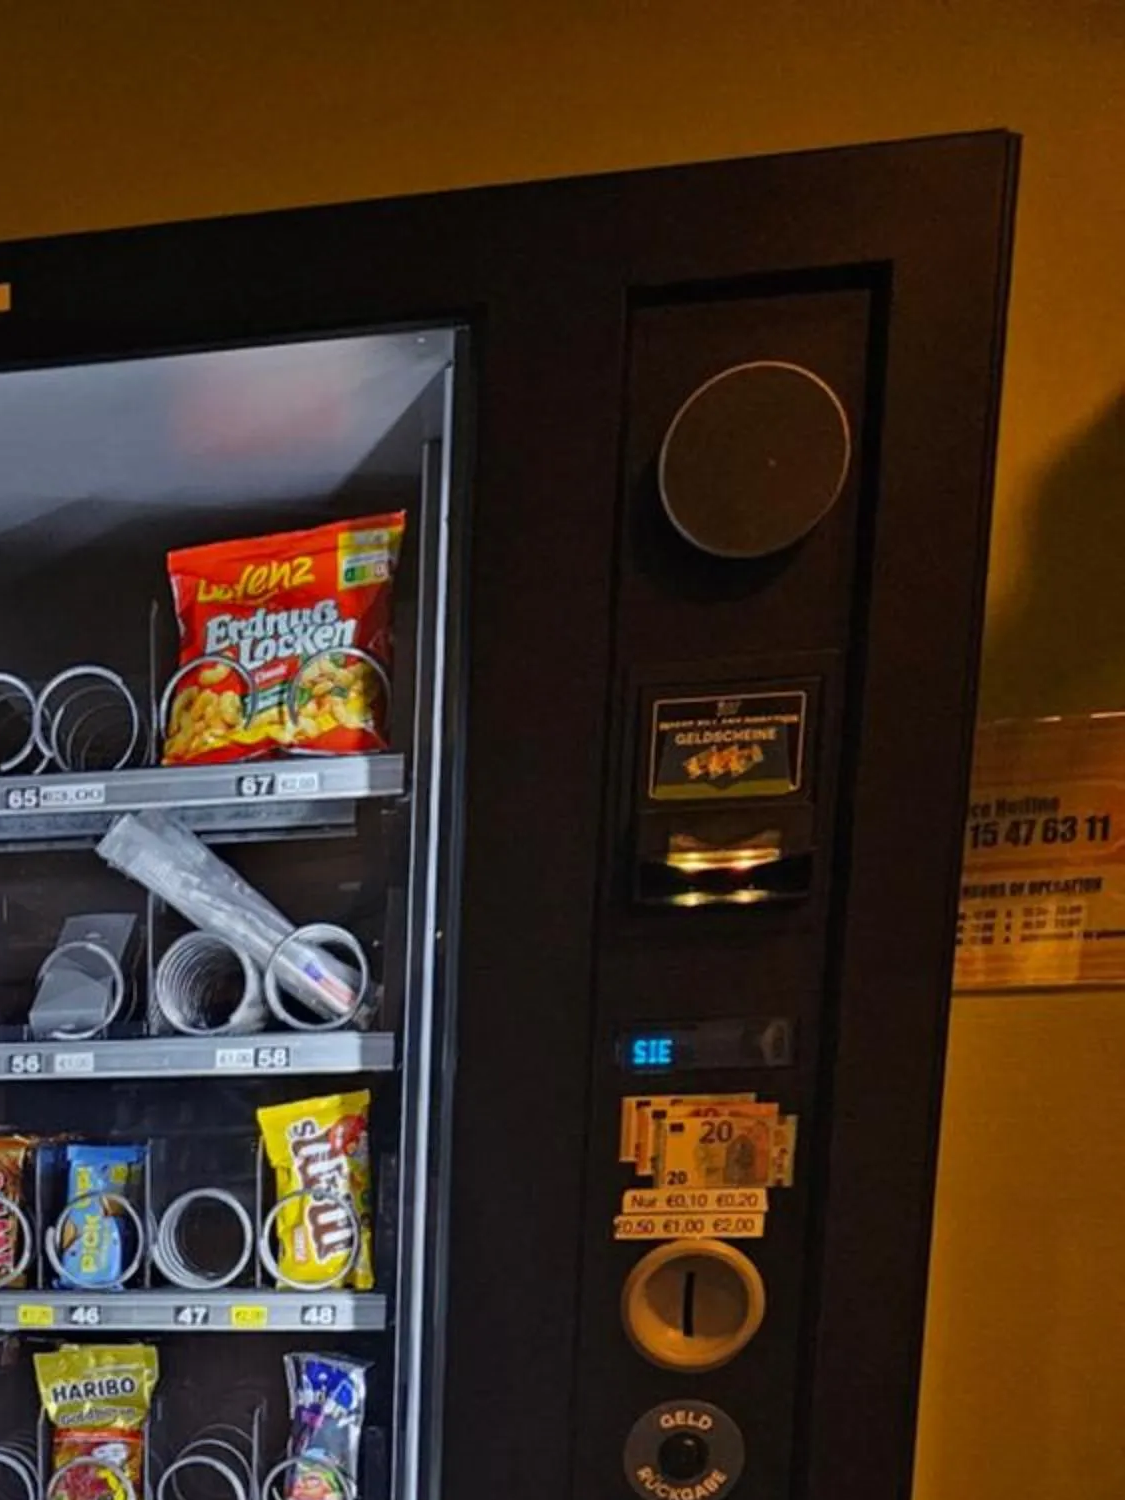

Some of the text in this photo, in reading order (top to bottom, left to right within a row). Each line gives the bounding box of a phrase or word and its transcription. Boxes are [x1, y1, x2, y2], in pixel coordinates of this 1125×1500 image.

[240, 619, 357, 671] Locken
[674, 727, 777, 745] GELDSCHEINE
[242, 774, 272, 795] 67
[9, 790, 38, 808] 65
[1005, 819, 1036, 847] 47
[1042, 815, 1078, 844] 63
[1085, 814, 1111, 841] 11
[258, 1049, 286, 1067] 58
[632, 1039, 673, 1065] SIE
[12, 1054, 40, 1072] 56
[699, 1120, 733, 1144] 20
[667, 1170, 688, 1186] 20
[666, 1193, 708, 1208] €0.10
[715, 1192, 759, 1207] €0.20
[663, 1218, 704, 1234] €1.00
[713, 1217, 755, 1233] €2.00
[72, 1307, 100, 1323] 46
[178, 1307, 207, 1323] 47
[304, 1306, 333, 1324] 48
[50, 1377, 136, 1403] HARIBO
[659, 1409, 713, 1431] GELD
